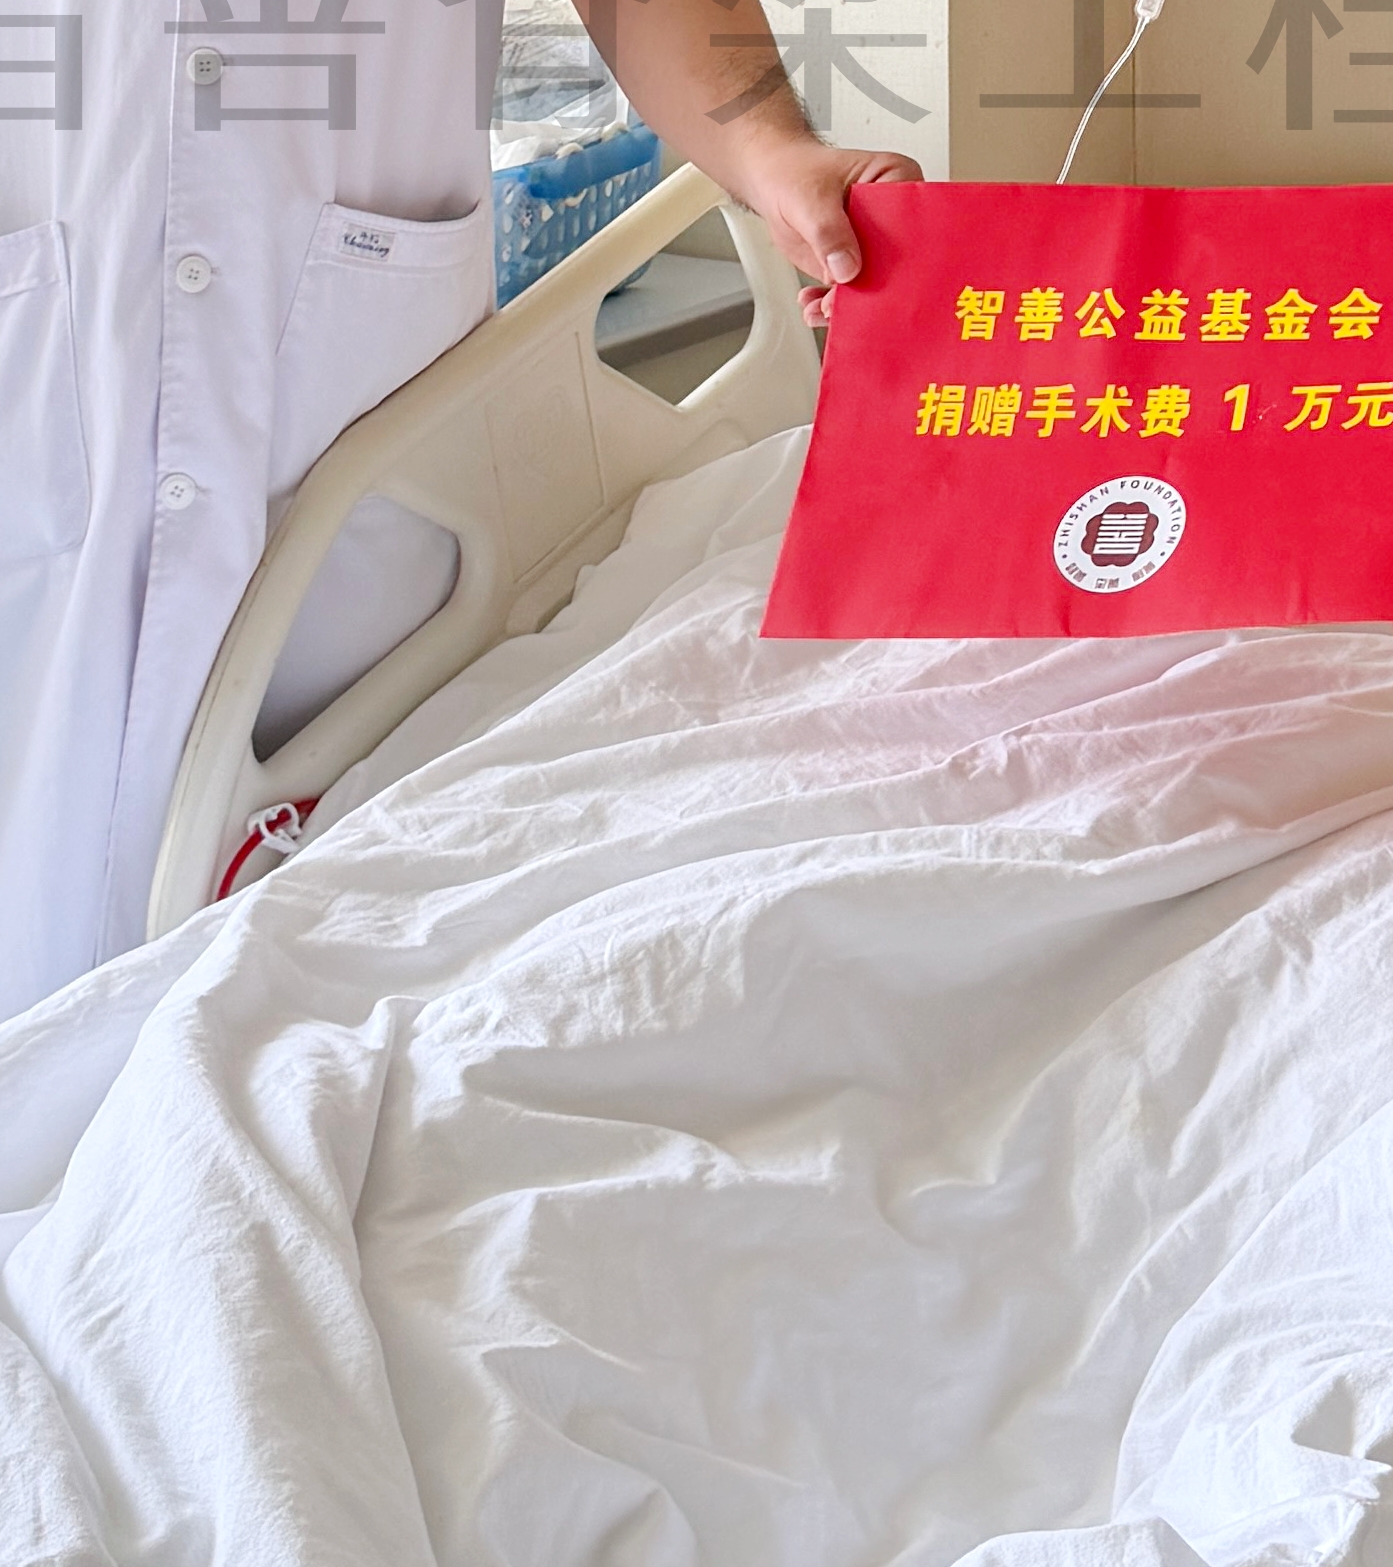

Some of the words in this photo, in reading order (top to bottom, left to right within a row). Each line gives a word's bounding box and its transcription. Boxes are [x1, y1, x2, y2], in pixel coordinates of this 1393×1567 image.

[955, 286, 1382, 343] 智善公益基金会
[915, 383, 1191, 438] 捐赠手术费
[1223, 385, 1248, 432] 1
[1058, 486, 1110, 548] ZHISHAN
[1119, 479, 1182, 545] FOUNDATION
